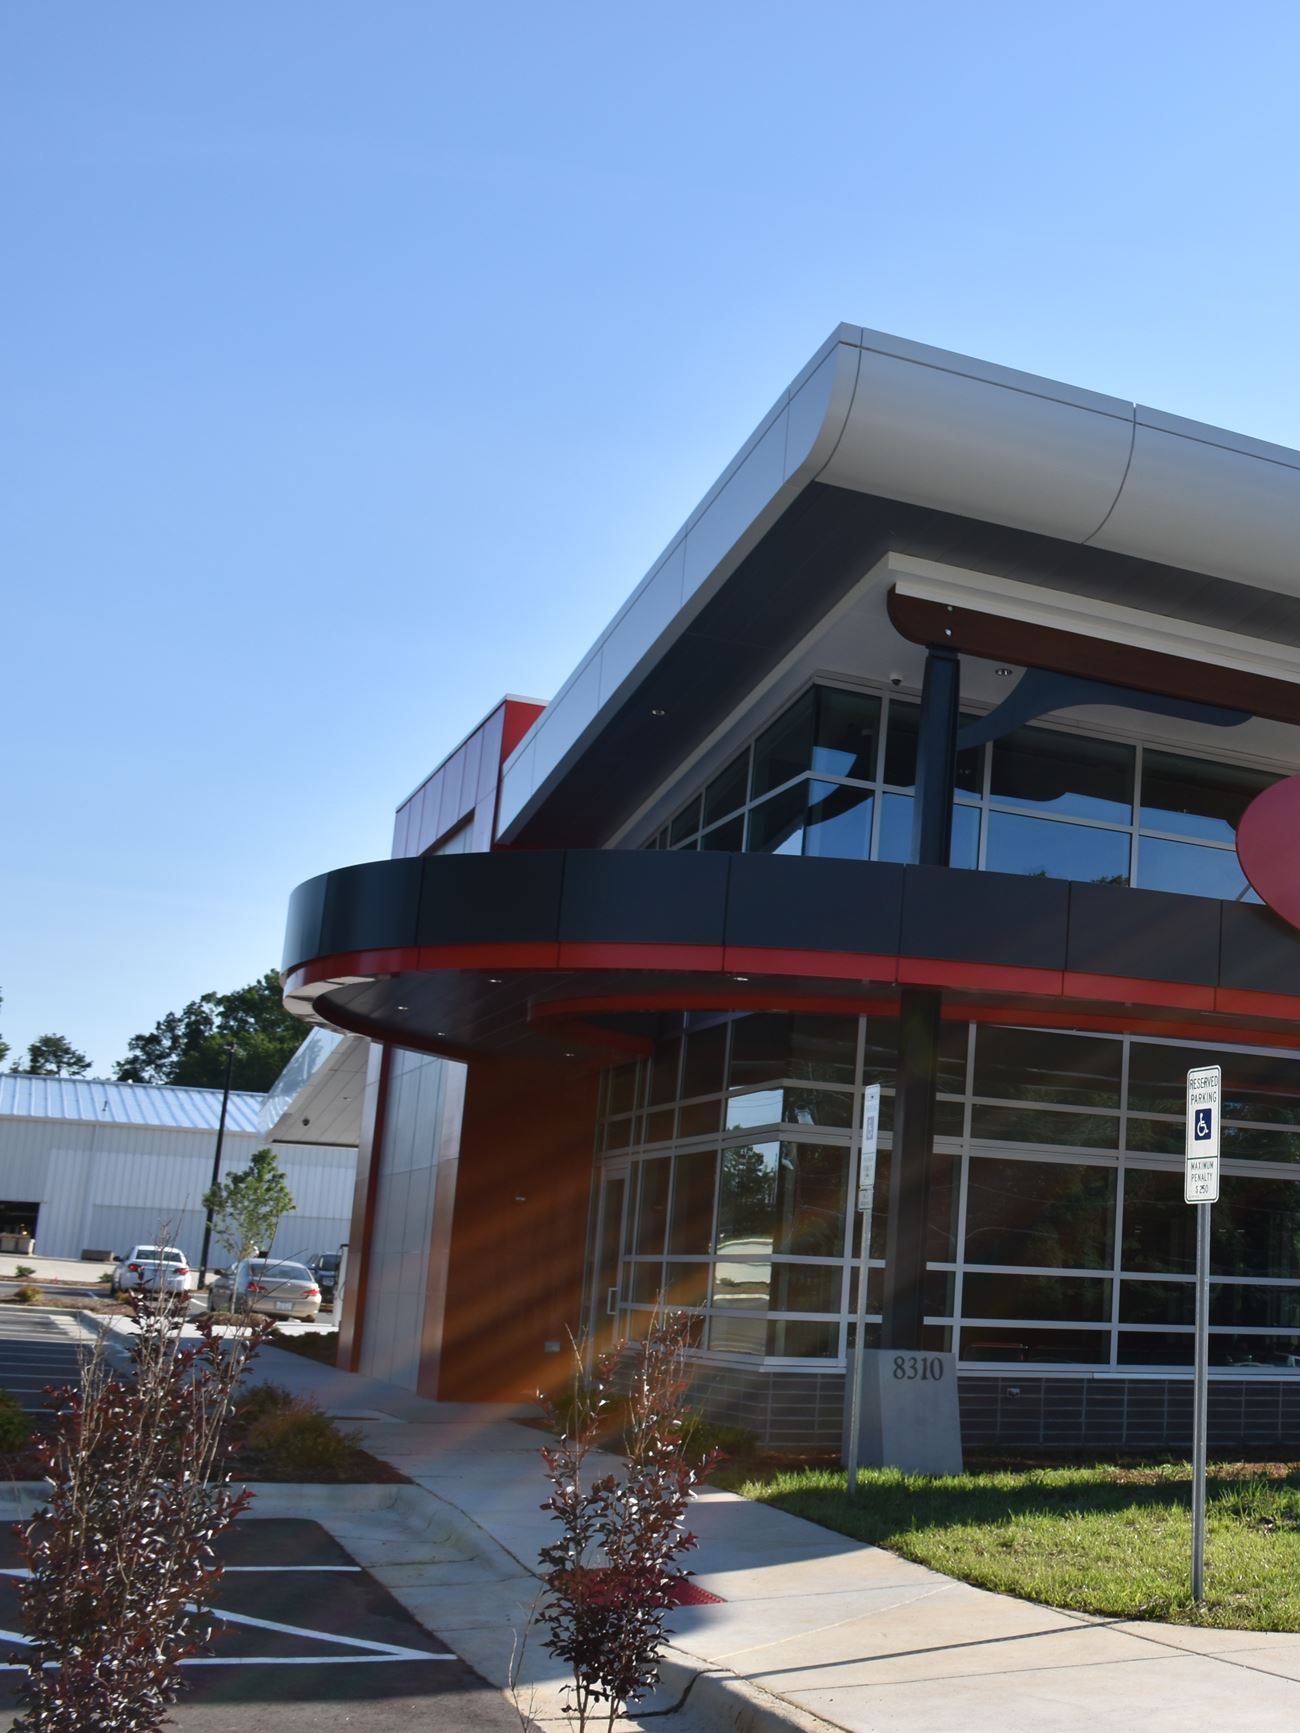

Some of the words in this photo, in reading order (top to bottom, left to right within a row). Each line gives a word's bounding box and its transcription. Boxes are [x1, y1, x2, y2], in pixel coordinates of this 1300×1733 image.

[1190, 1075, 1218, 1089] RESERVED
[1191, 1091, 1216, 1105] PARKING
[1191, 1161, 1214, 1170] MAXIMUM
[1191, 1172, 1213, 1183] PENALTY
[893, 1355, 944, 1381] 8310
